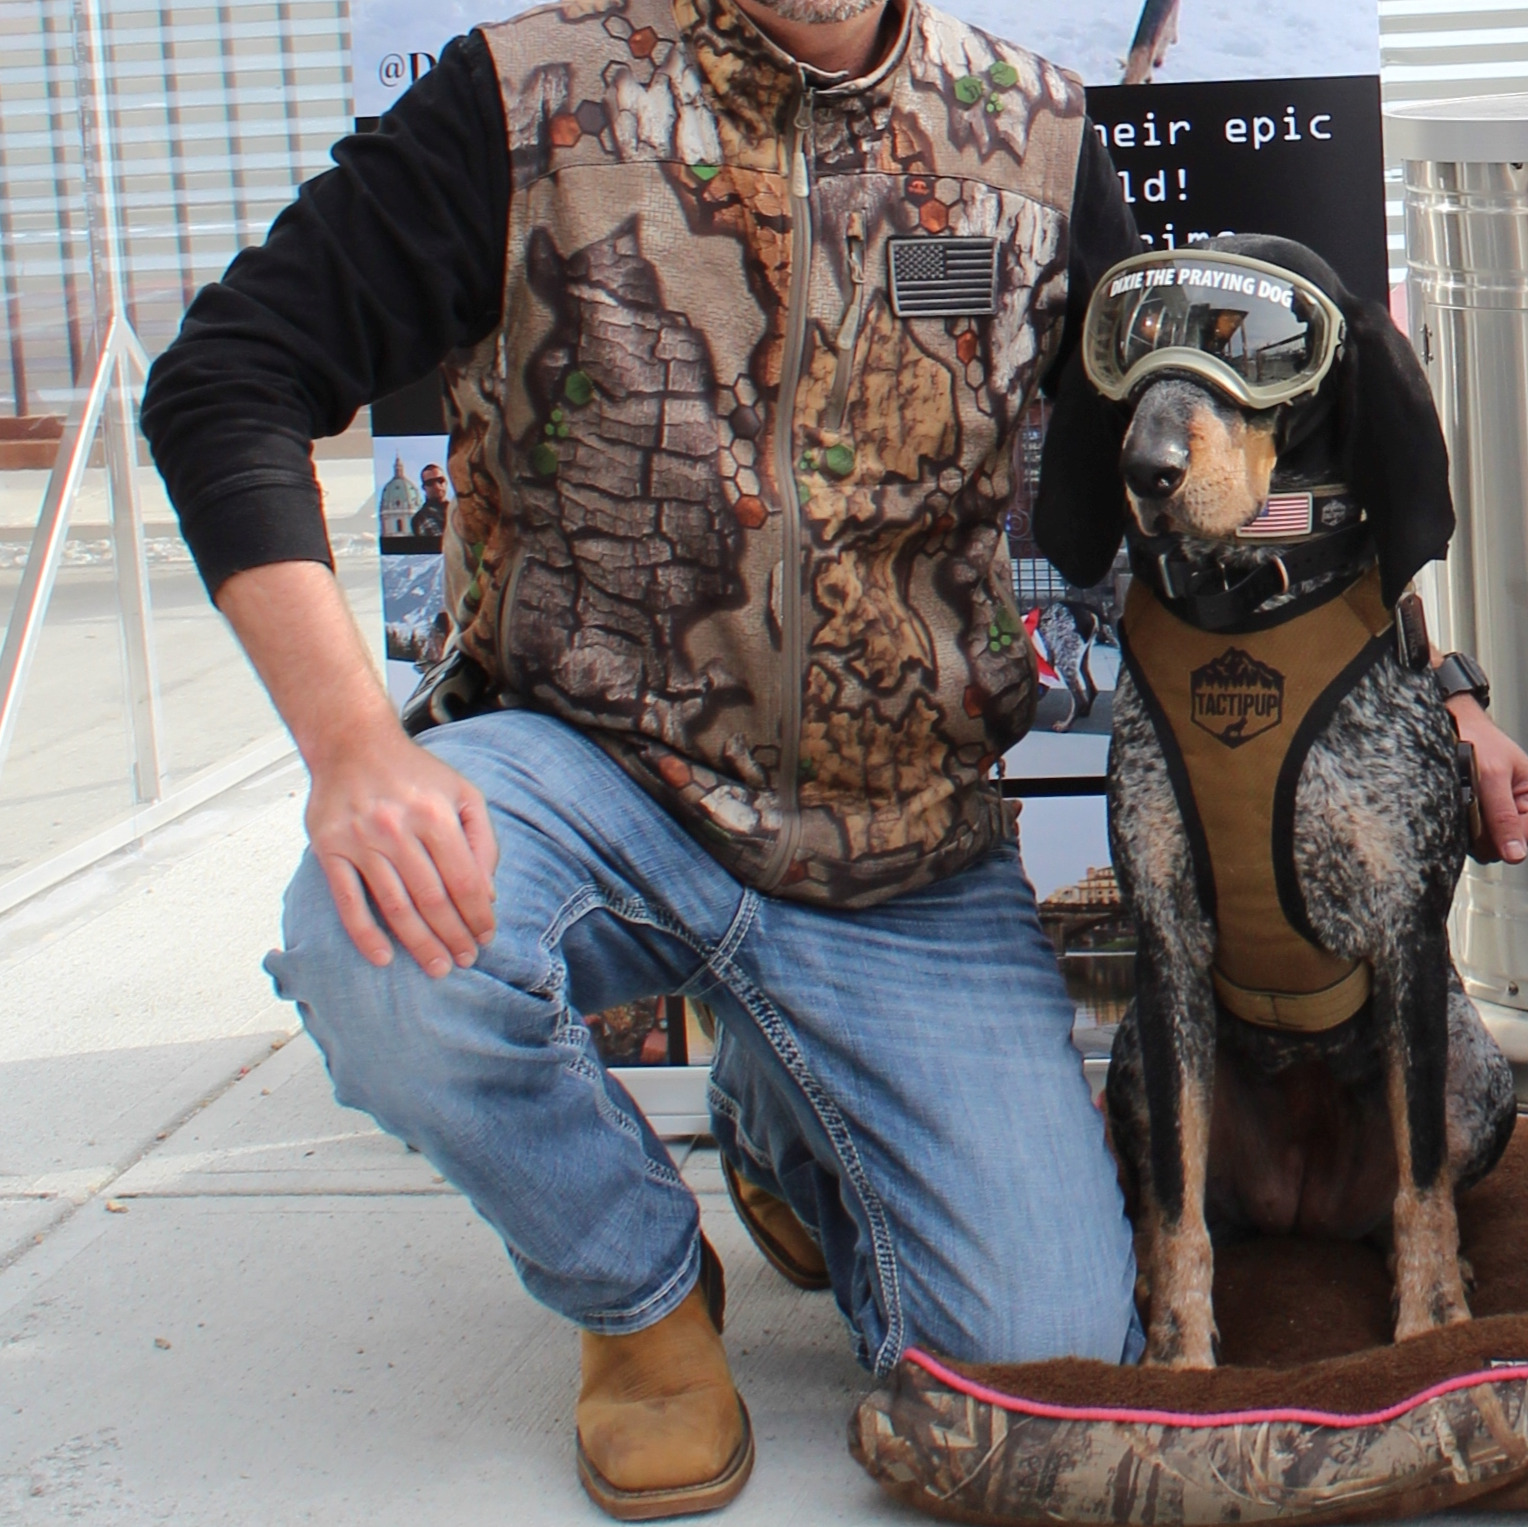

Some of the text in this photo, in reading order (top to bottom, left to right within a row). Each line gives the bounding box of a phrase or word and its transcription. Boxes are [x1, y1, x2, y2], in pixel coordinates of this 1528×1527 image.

[1091, 105, 1333, 151] eir epic
[1110, 268, 1296, 309] DIXIE THE PRAYING DOG
[1196, 693, 1278, 718] TACTIPUP
